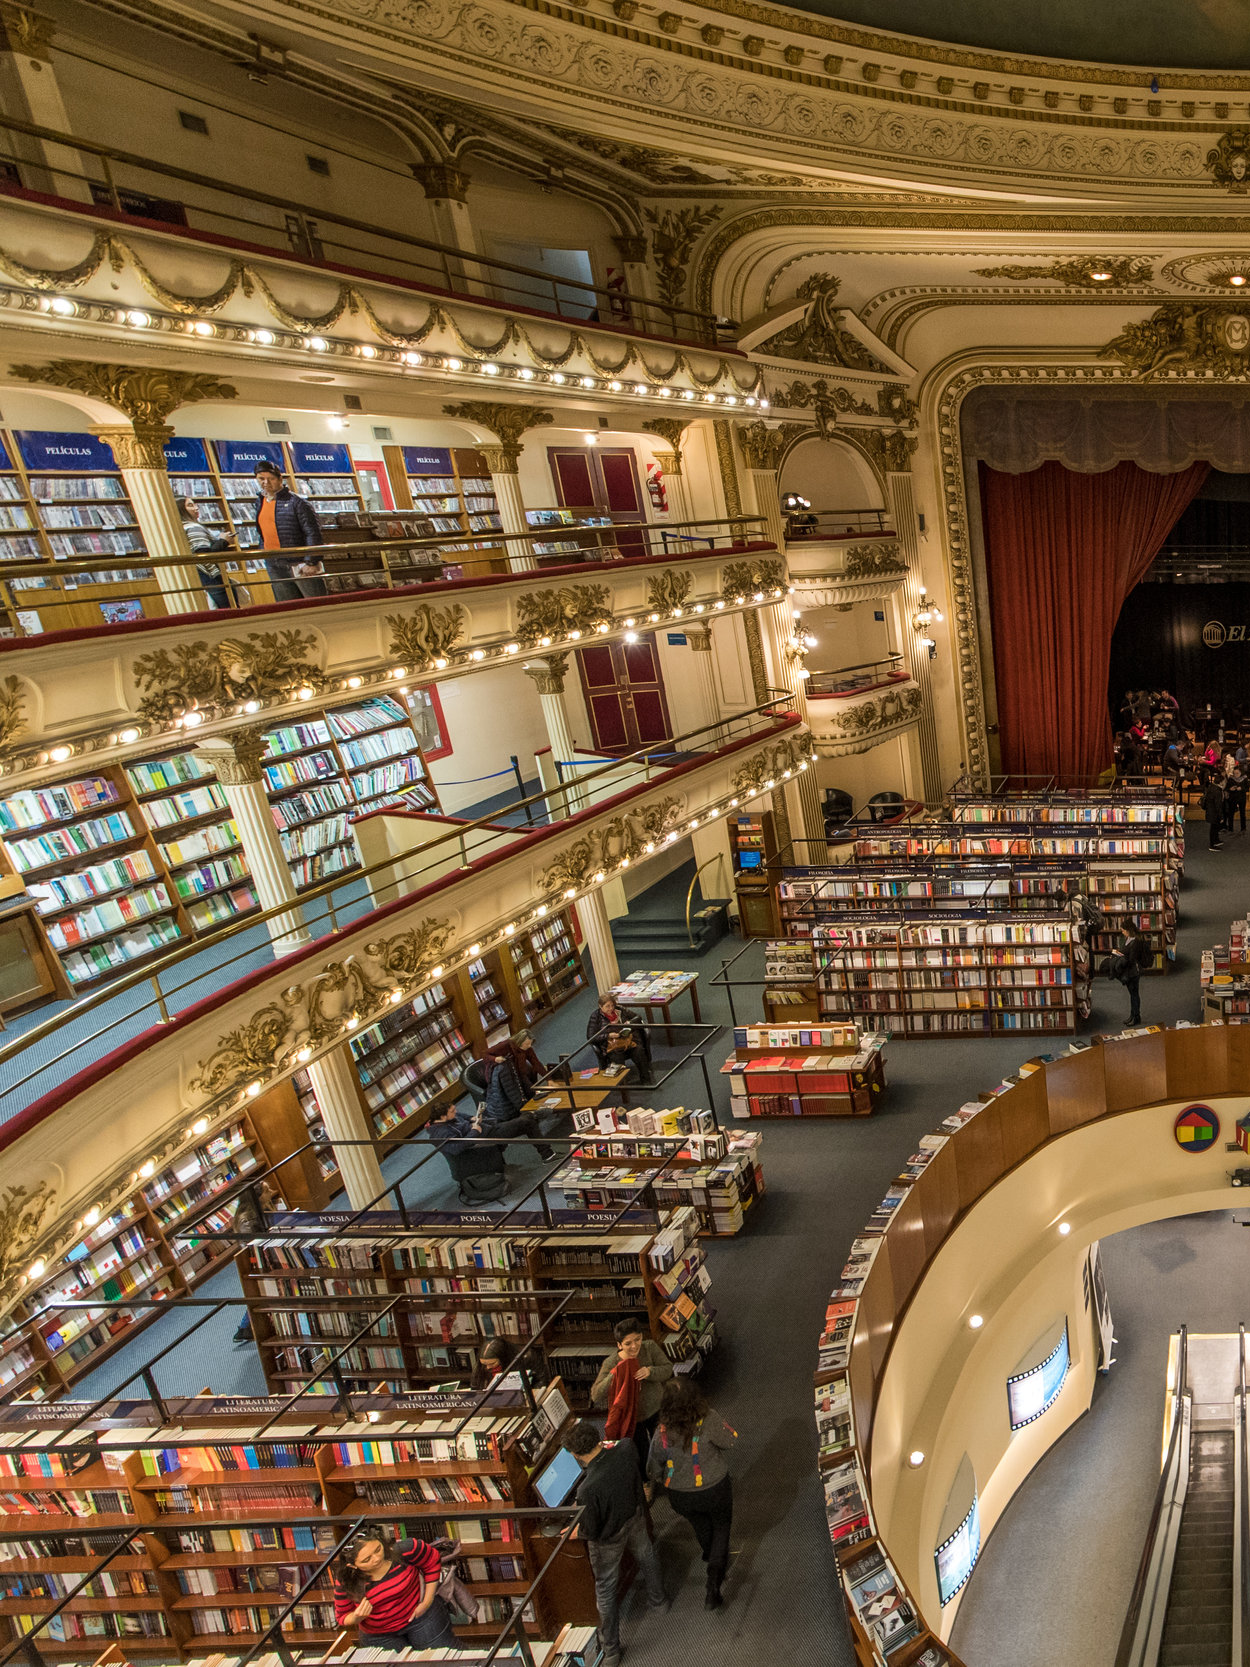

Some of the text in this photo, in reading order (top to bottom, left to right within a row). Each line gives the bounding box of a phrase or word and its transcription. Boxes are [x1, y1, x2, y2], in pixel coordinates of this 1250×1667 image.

[45, 446, 92, 456] PELÍCULAS
[1226, 625, 1246, 642] El
[26, 1412, 110, 1420] LATINOAMERANA
